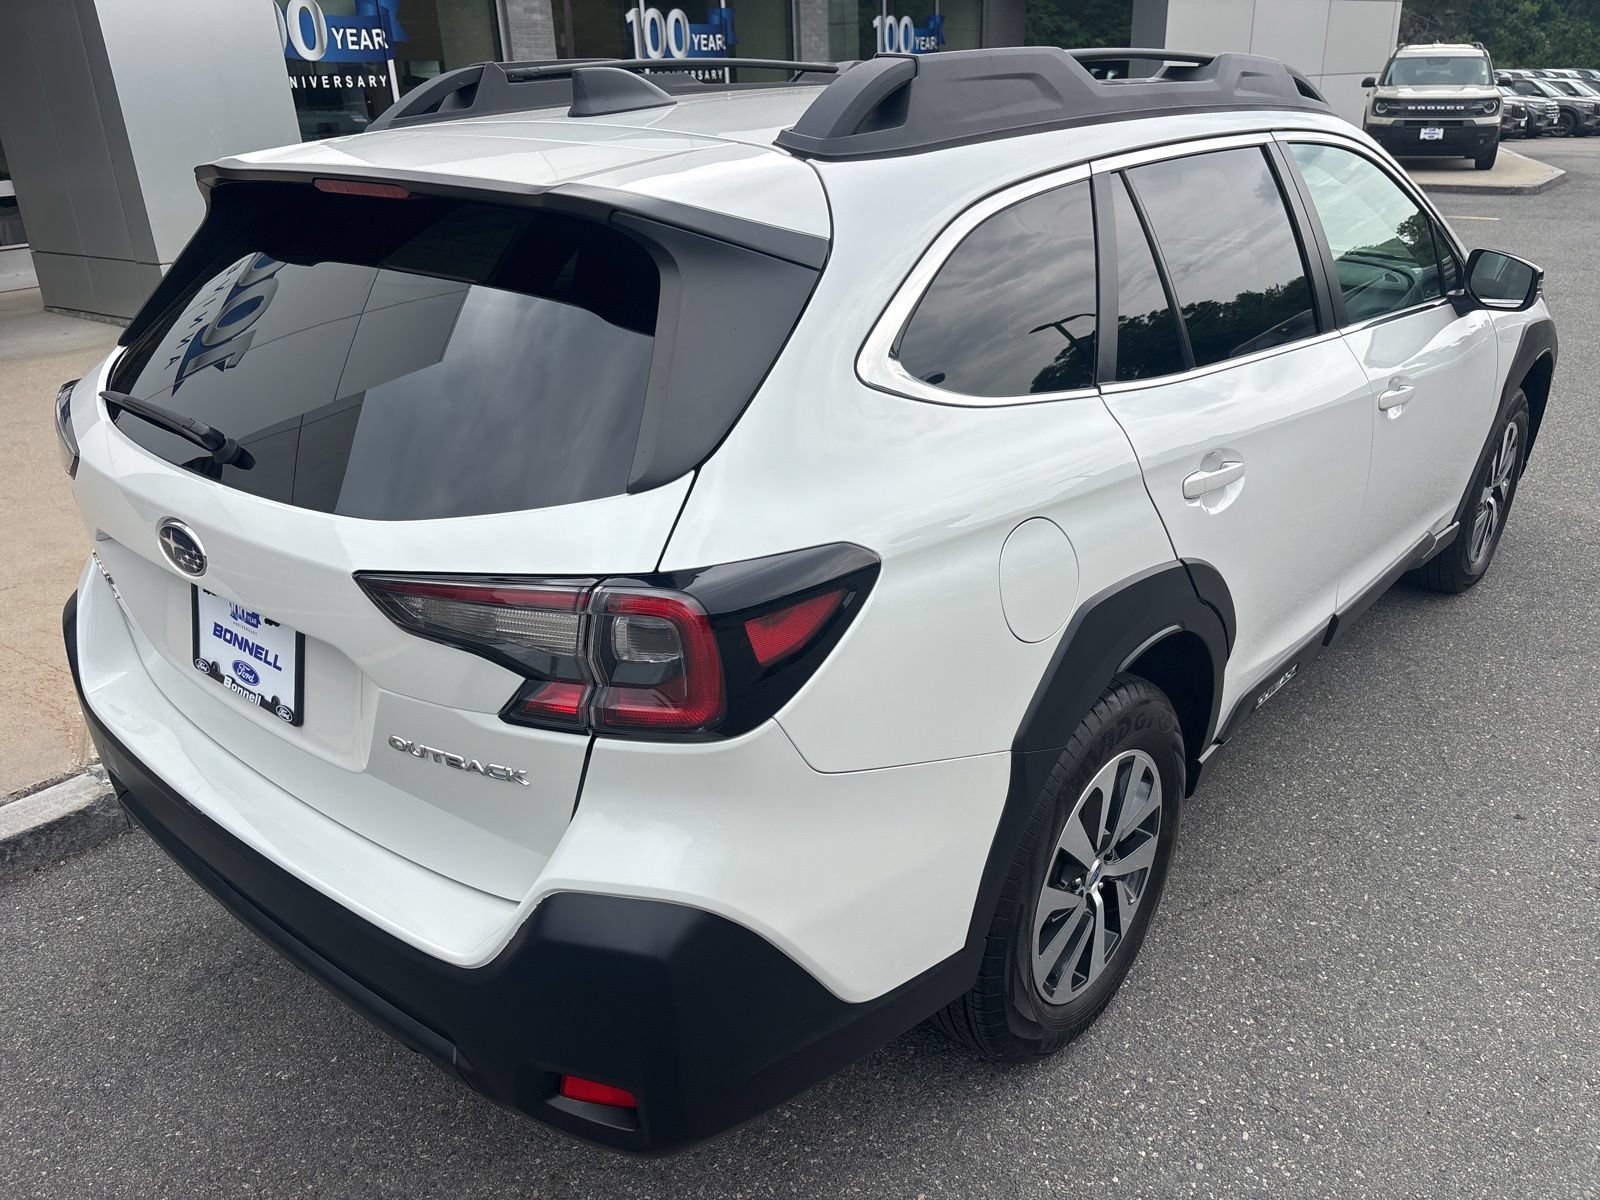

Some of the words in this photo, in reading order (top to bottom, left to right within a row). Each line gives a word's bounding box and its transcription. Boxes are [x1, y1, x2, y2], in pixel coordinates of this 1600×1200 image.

[331, 27, 389, 50] YEAR
[625, 7, 690, 60] 100
[872, 15, 915, 54] 100
[914, 36, 938, 51] YEAR
[212, 621, 282, 672] BONNELL
[223, 675, 262, 706] Bonnell
[233, 661, 258, 685] Ford
[388, 735, 531, 786] OUTBACK
